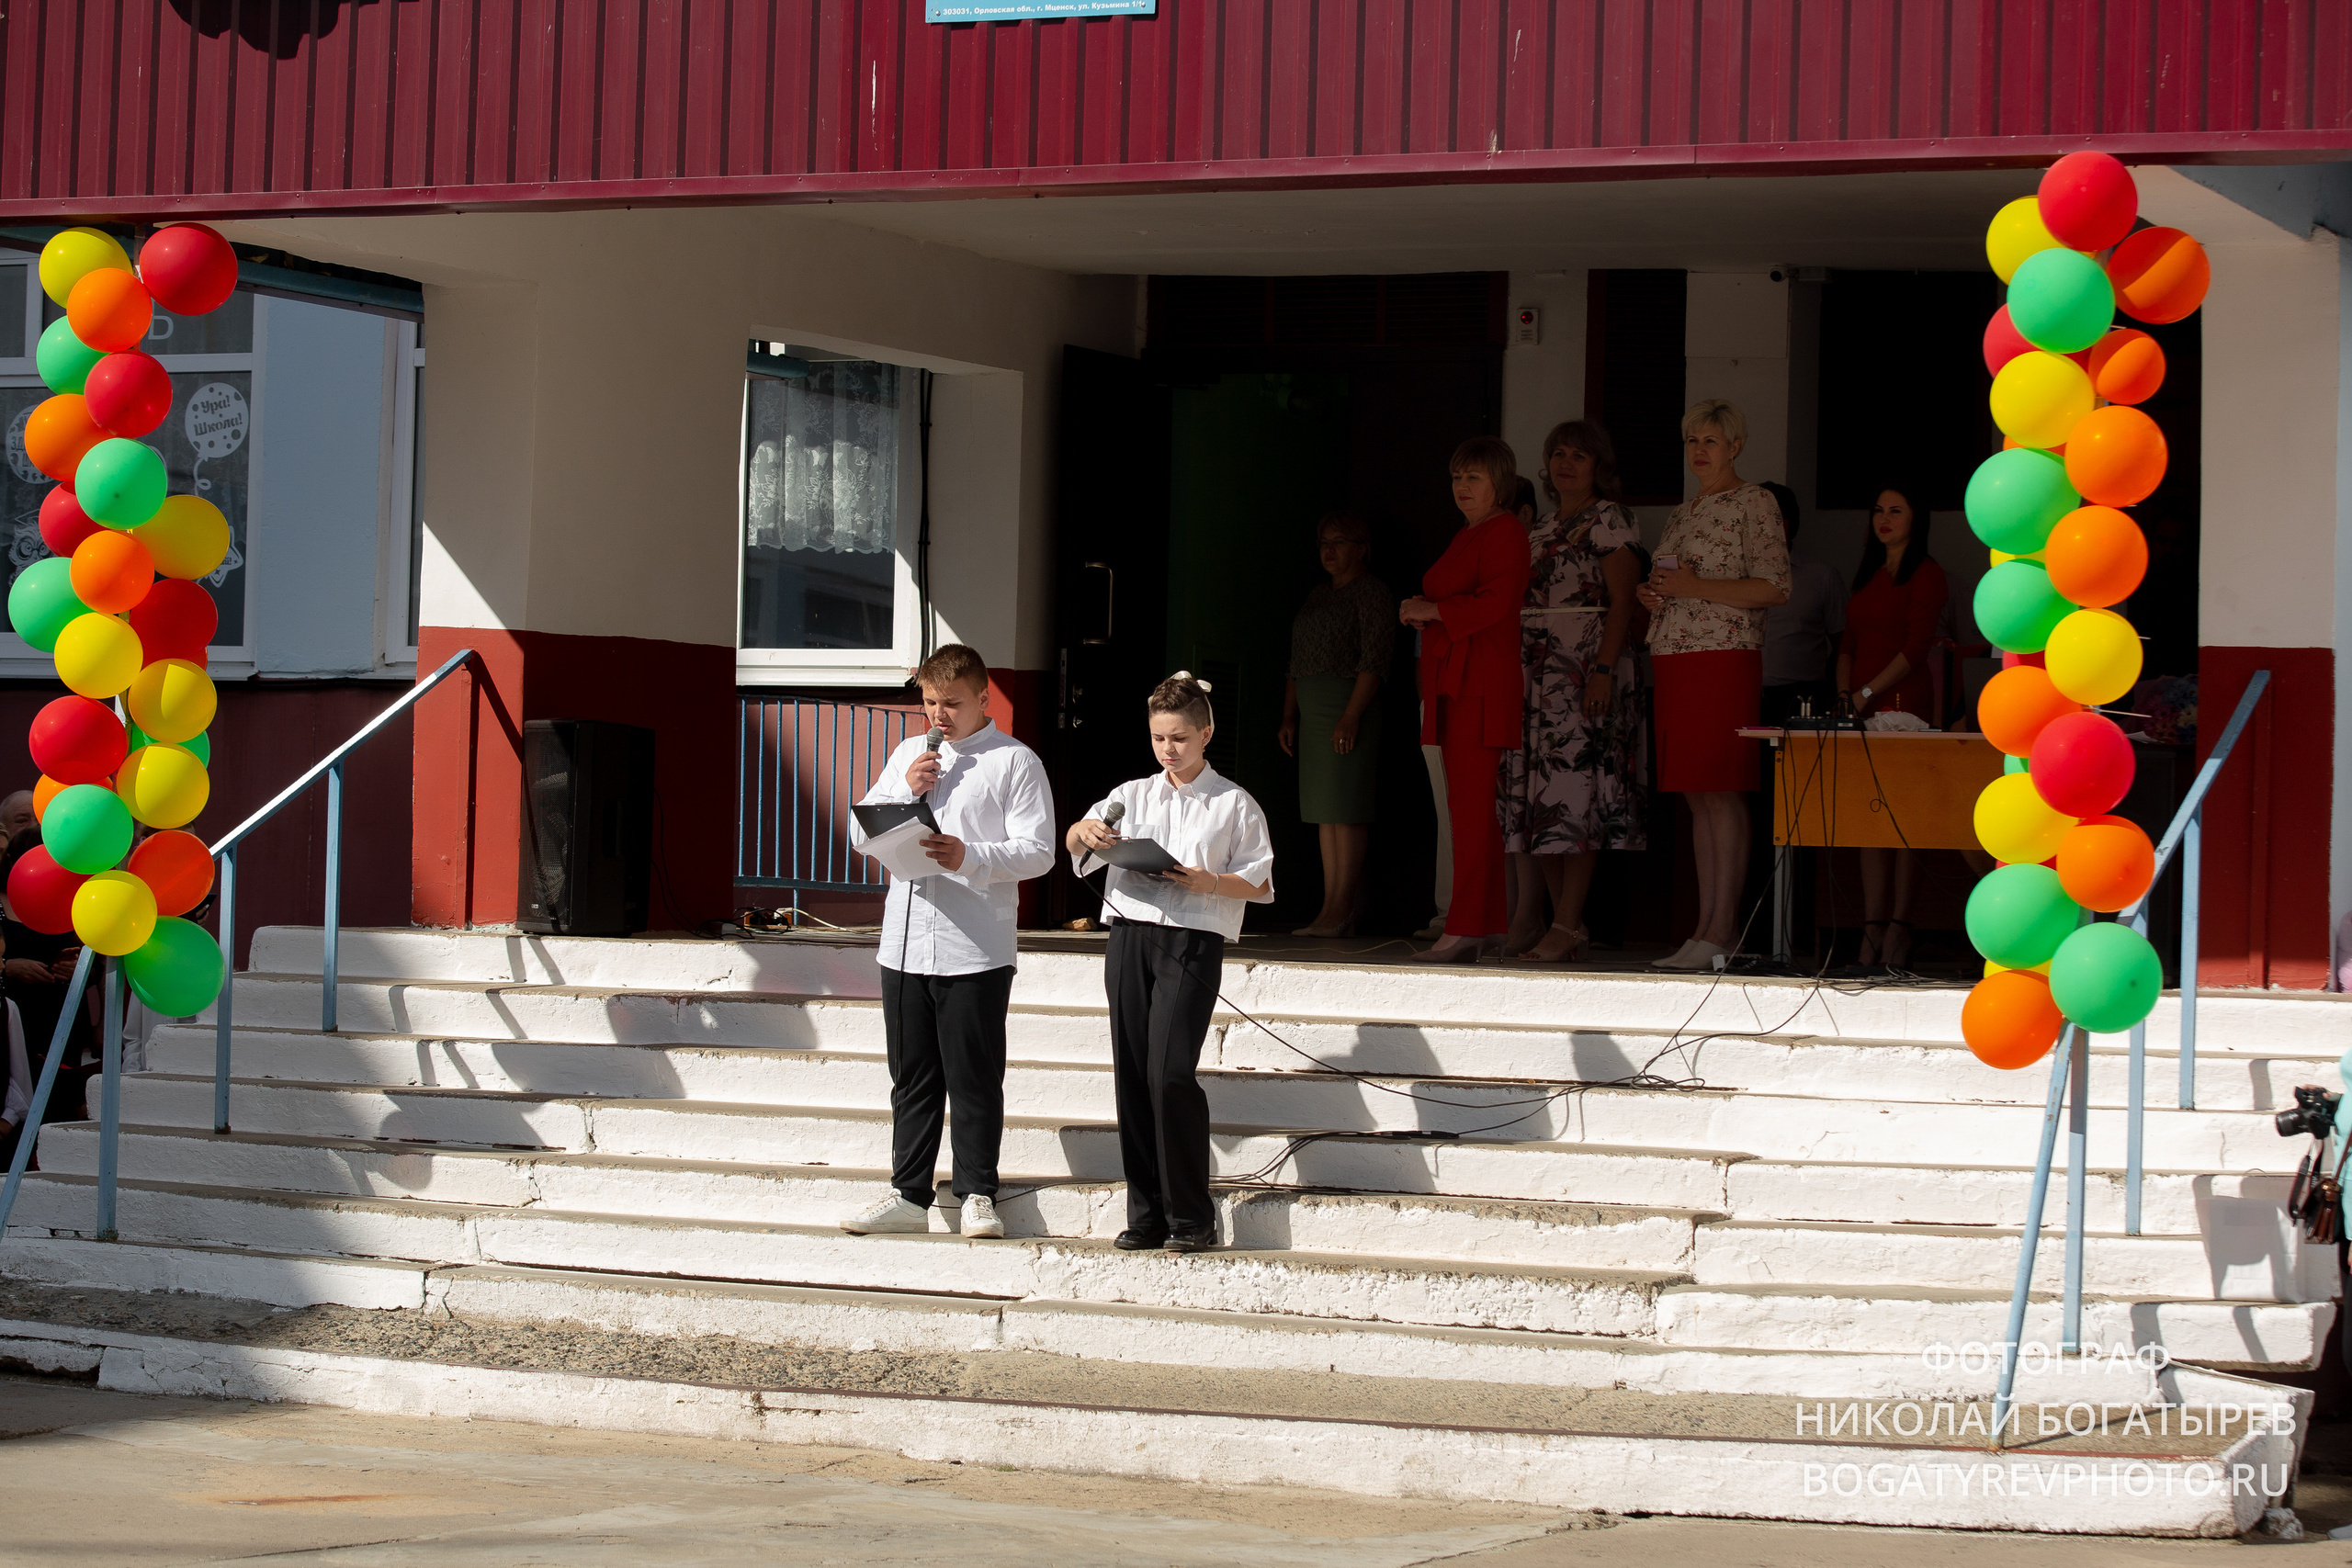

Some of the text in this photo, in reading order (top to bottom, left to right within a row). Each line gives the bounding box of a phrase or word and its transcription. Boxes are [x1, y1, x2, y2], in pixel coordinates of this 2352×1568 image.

[943, 7, 972, 16] 303031,
[974, 6, 1014, 16] Орловская
[1045, 4, 1077, 12] Мценск,
[1091, 2, 1130, 10] Кузьмина
[200, 395, 231, 414] Ура!
[193, 412, 243, 436] Школа!
